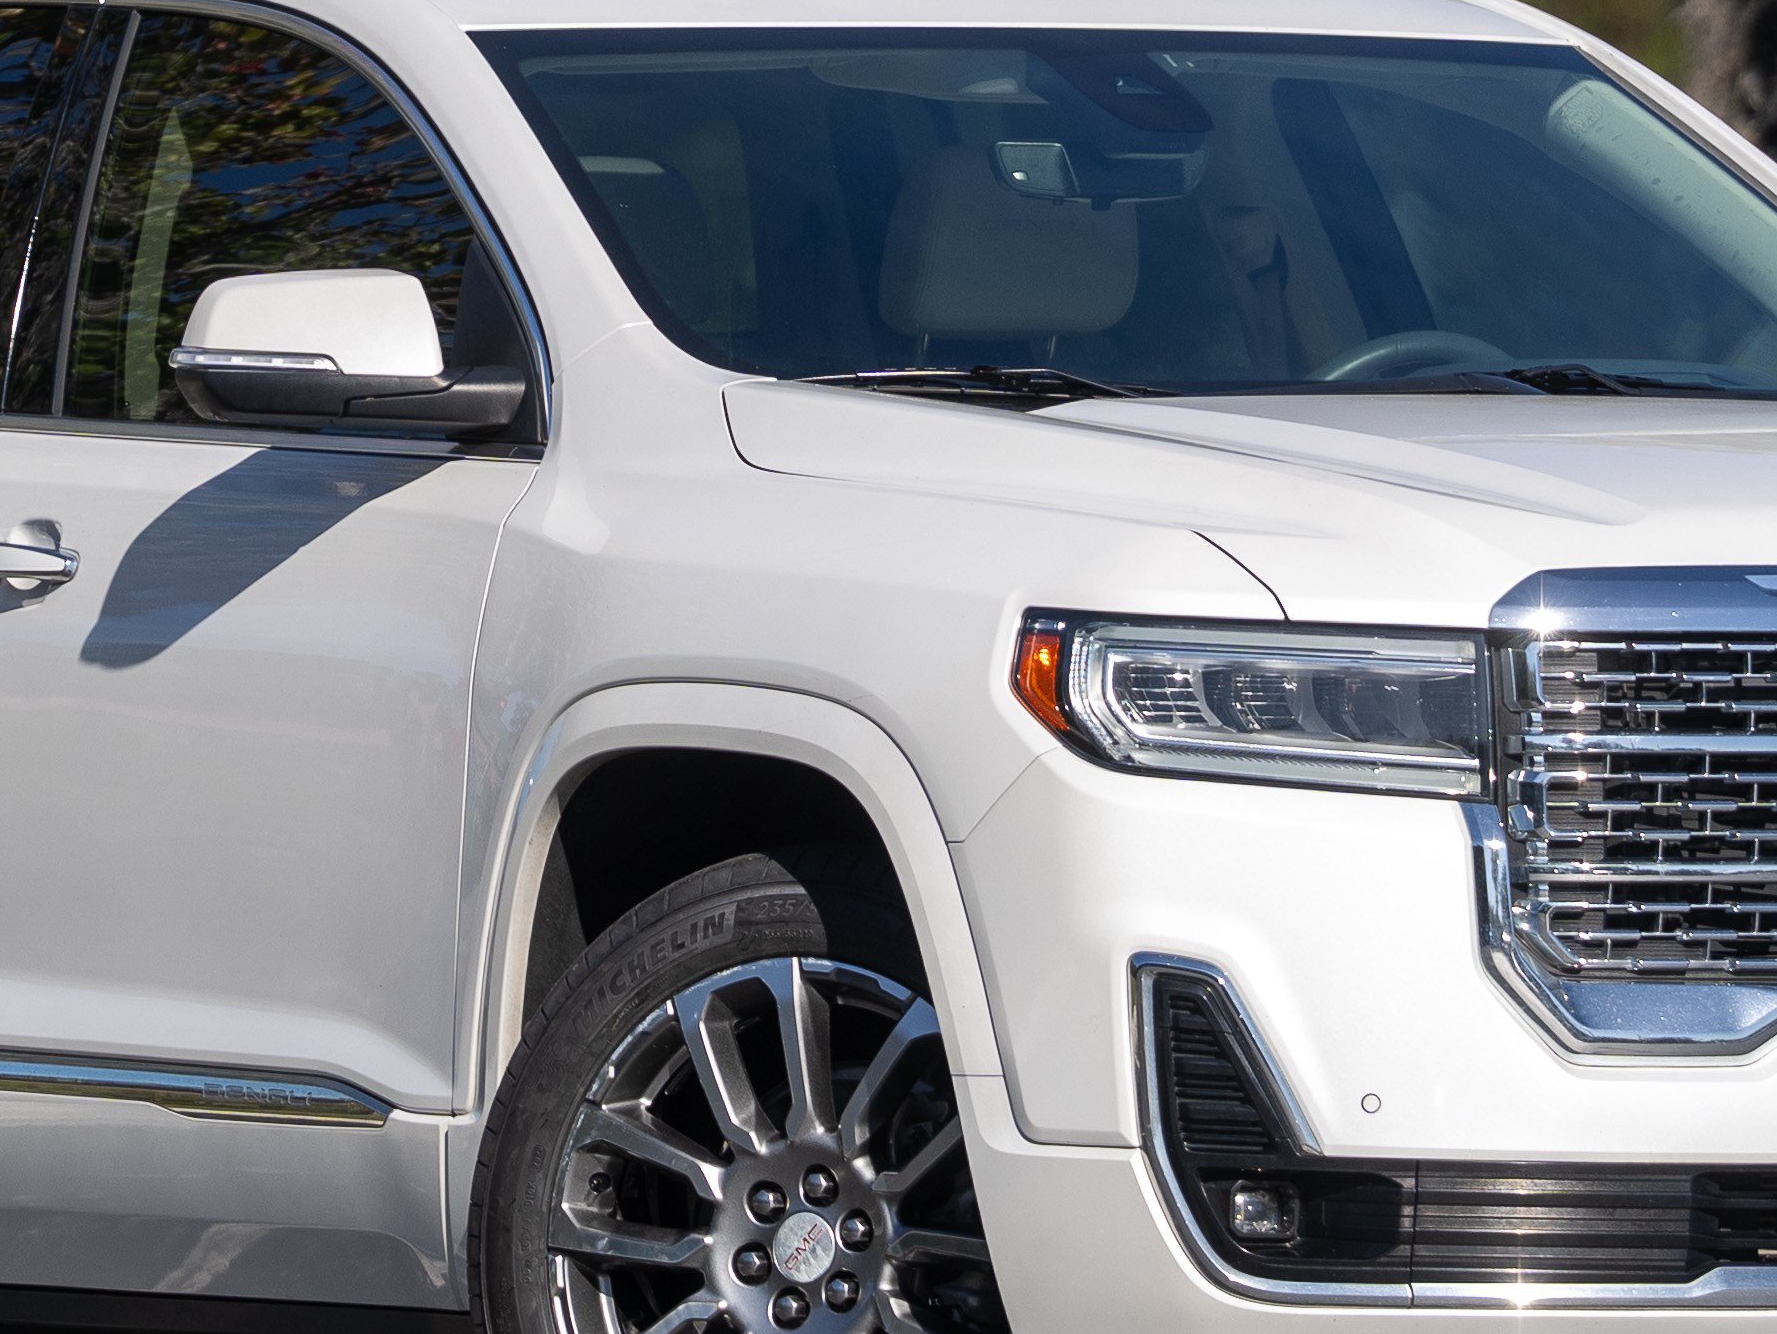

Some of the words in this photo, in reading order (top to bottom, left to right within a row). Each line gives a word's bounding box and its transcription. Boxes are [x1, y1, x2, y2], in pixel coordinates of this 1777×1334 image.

[573, 911, 727, 1033] MICHELIN
[202, 1082, 313, 1106] DENALI
[784, 1222, 825, 1271] GMC
